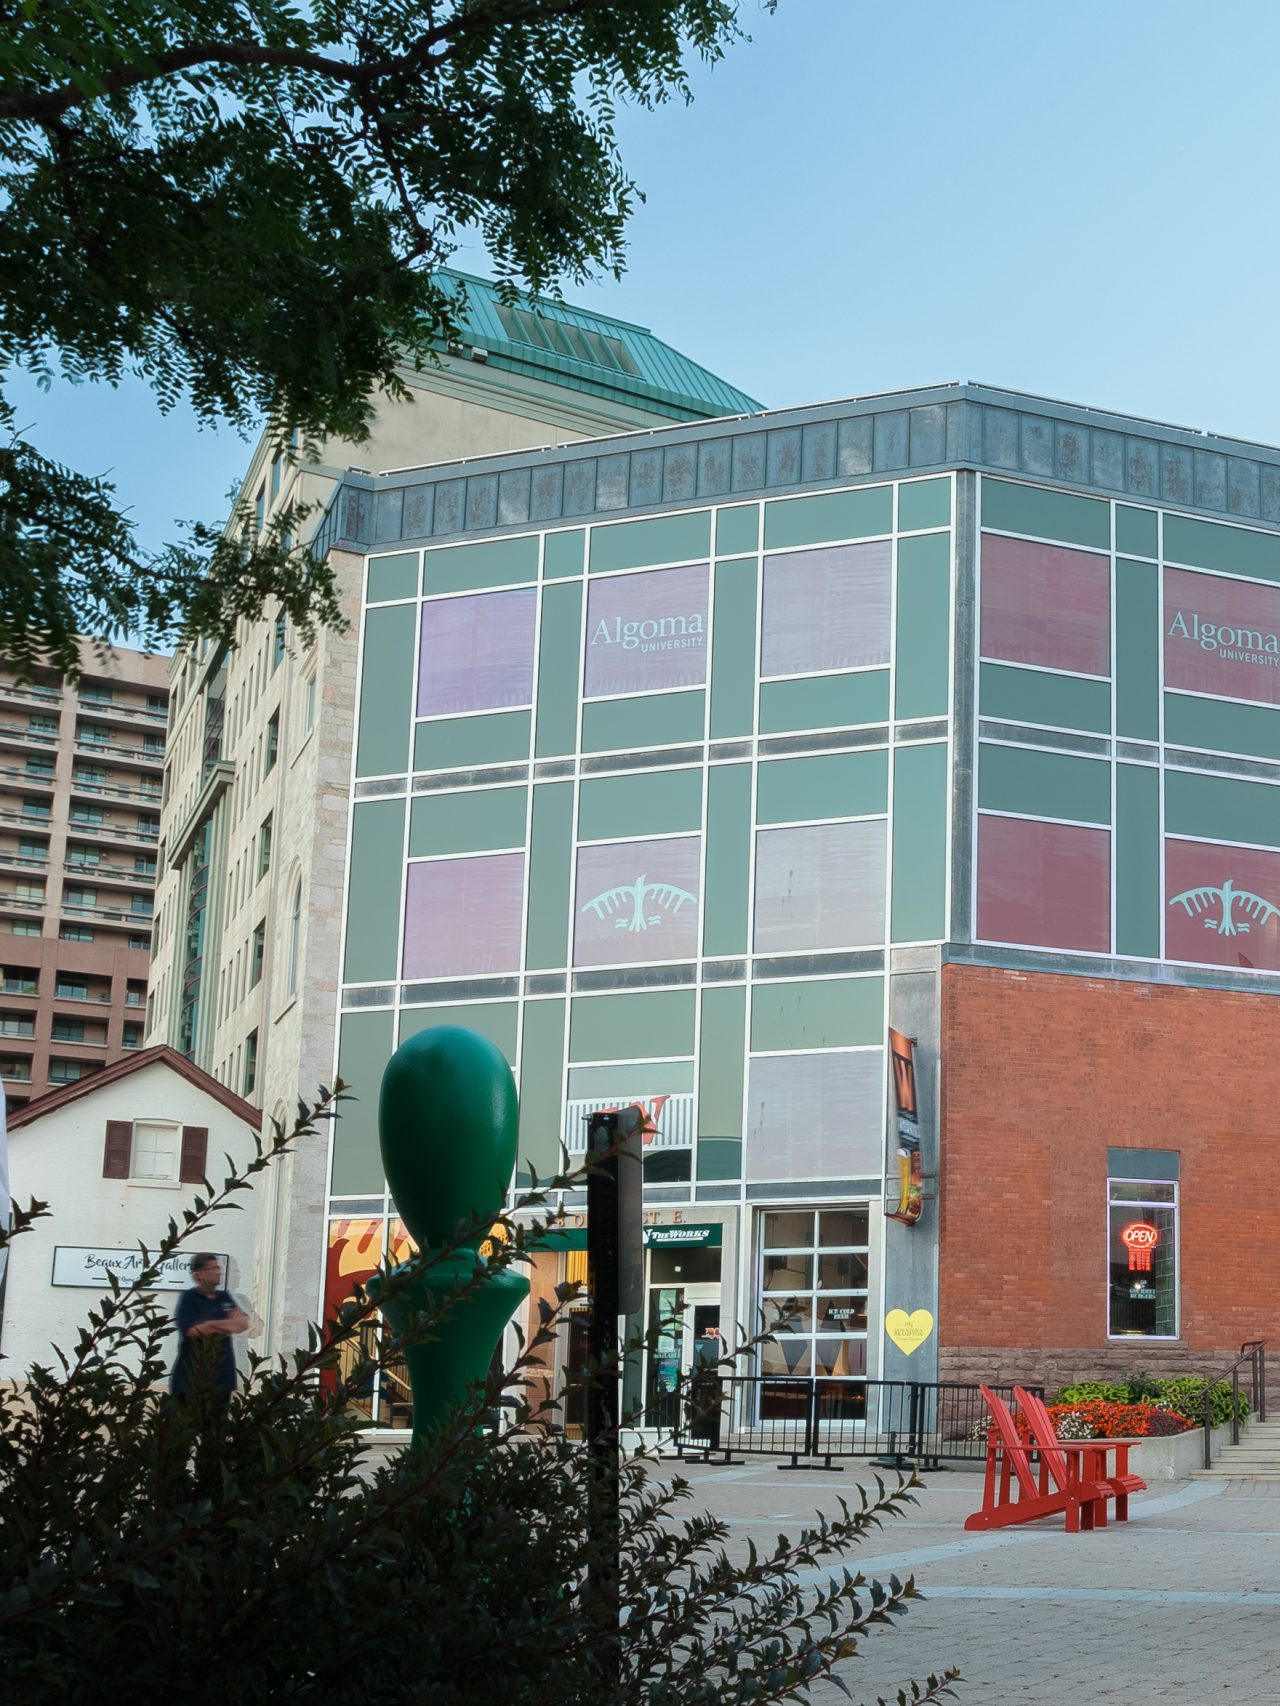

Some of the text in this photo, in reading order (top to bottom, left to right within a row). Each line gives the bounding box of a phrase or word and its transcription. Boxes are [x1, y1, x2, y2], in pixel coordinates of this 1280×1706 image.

[590, 613, 705, 650] Algoma
[1167, 611, 1280, 654] Algoma
[641, 637, 704, 653] UNIVERSITY
[1219, 648, 1280, 667] UNIVERSITY
[1126, 1230, 1155, 1243] OPEN
[84, 1254, 121, 1268] Beaux
